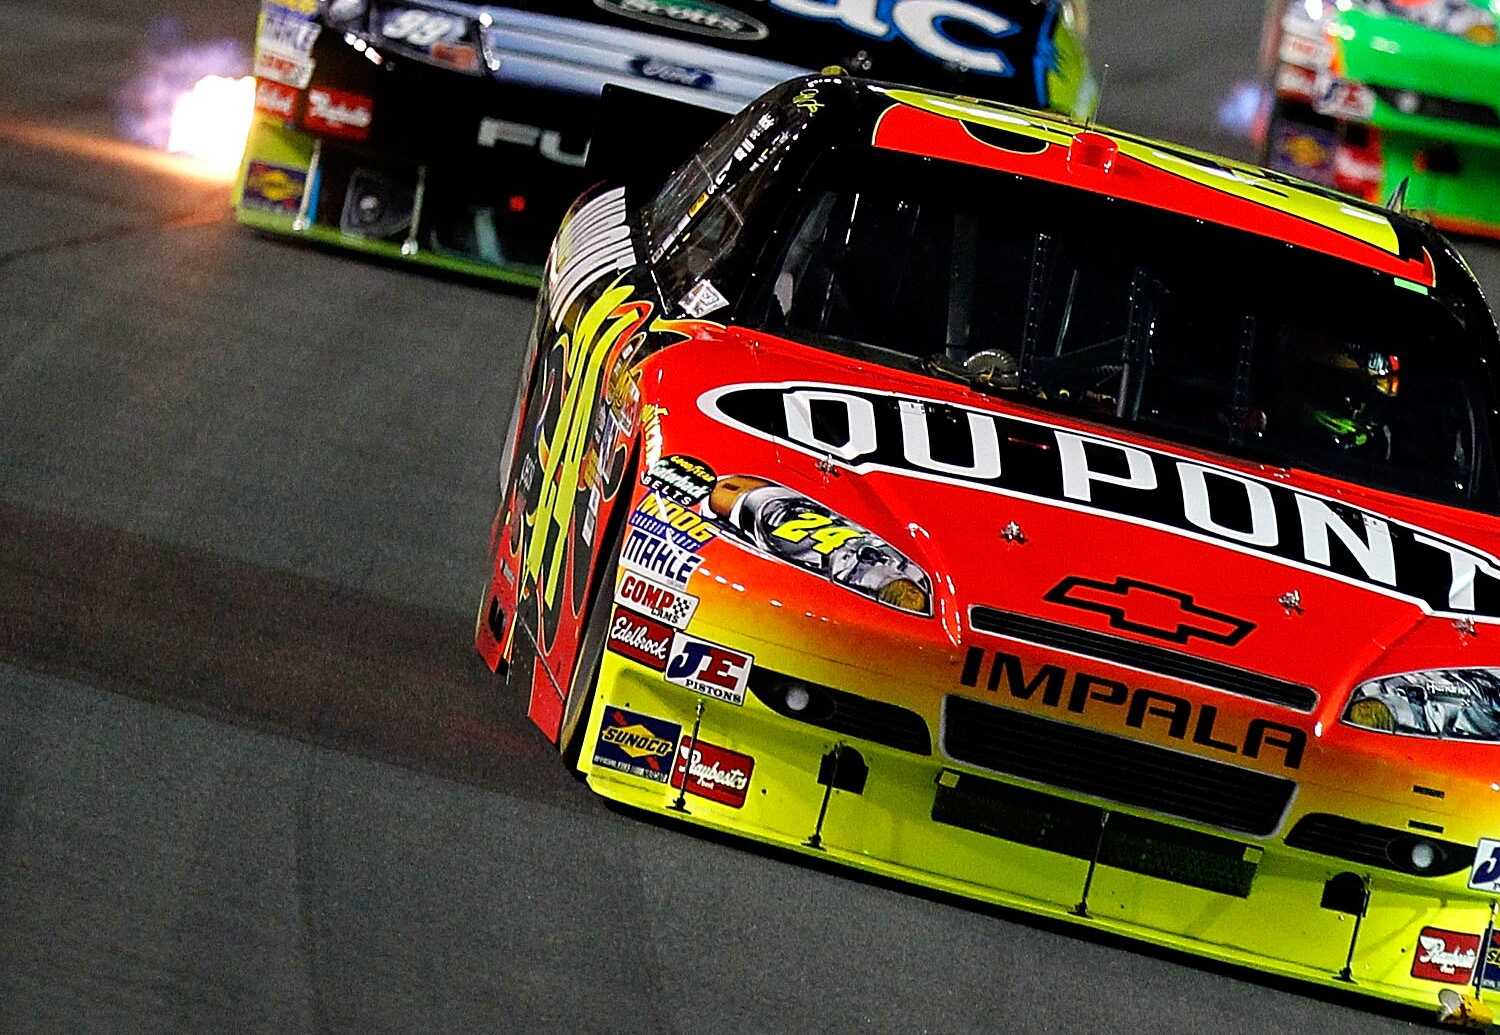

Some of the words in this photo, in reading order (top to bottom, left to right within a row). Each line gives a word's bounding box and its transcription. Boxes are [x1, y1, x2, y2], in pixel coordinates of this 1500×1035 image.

[642, 475, 694, 506] BELTS
[636, 492, 721, 543] MOOG
[771, 512, 865, 555] 24
[620, 575, 675, 611] COMP
[610, 616, 670, 660] Edelbrock
[666, 641, 748, 691] JE
[685, 678, 743, 704] PISTONS
[960, 645, 1307, 770] IMPALA
[602, 728, 672, 756] SUNOCO
